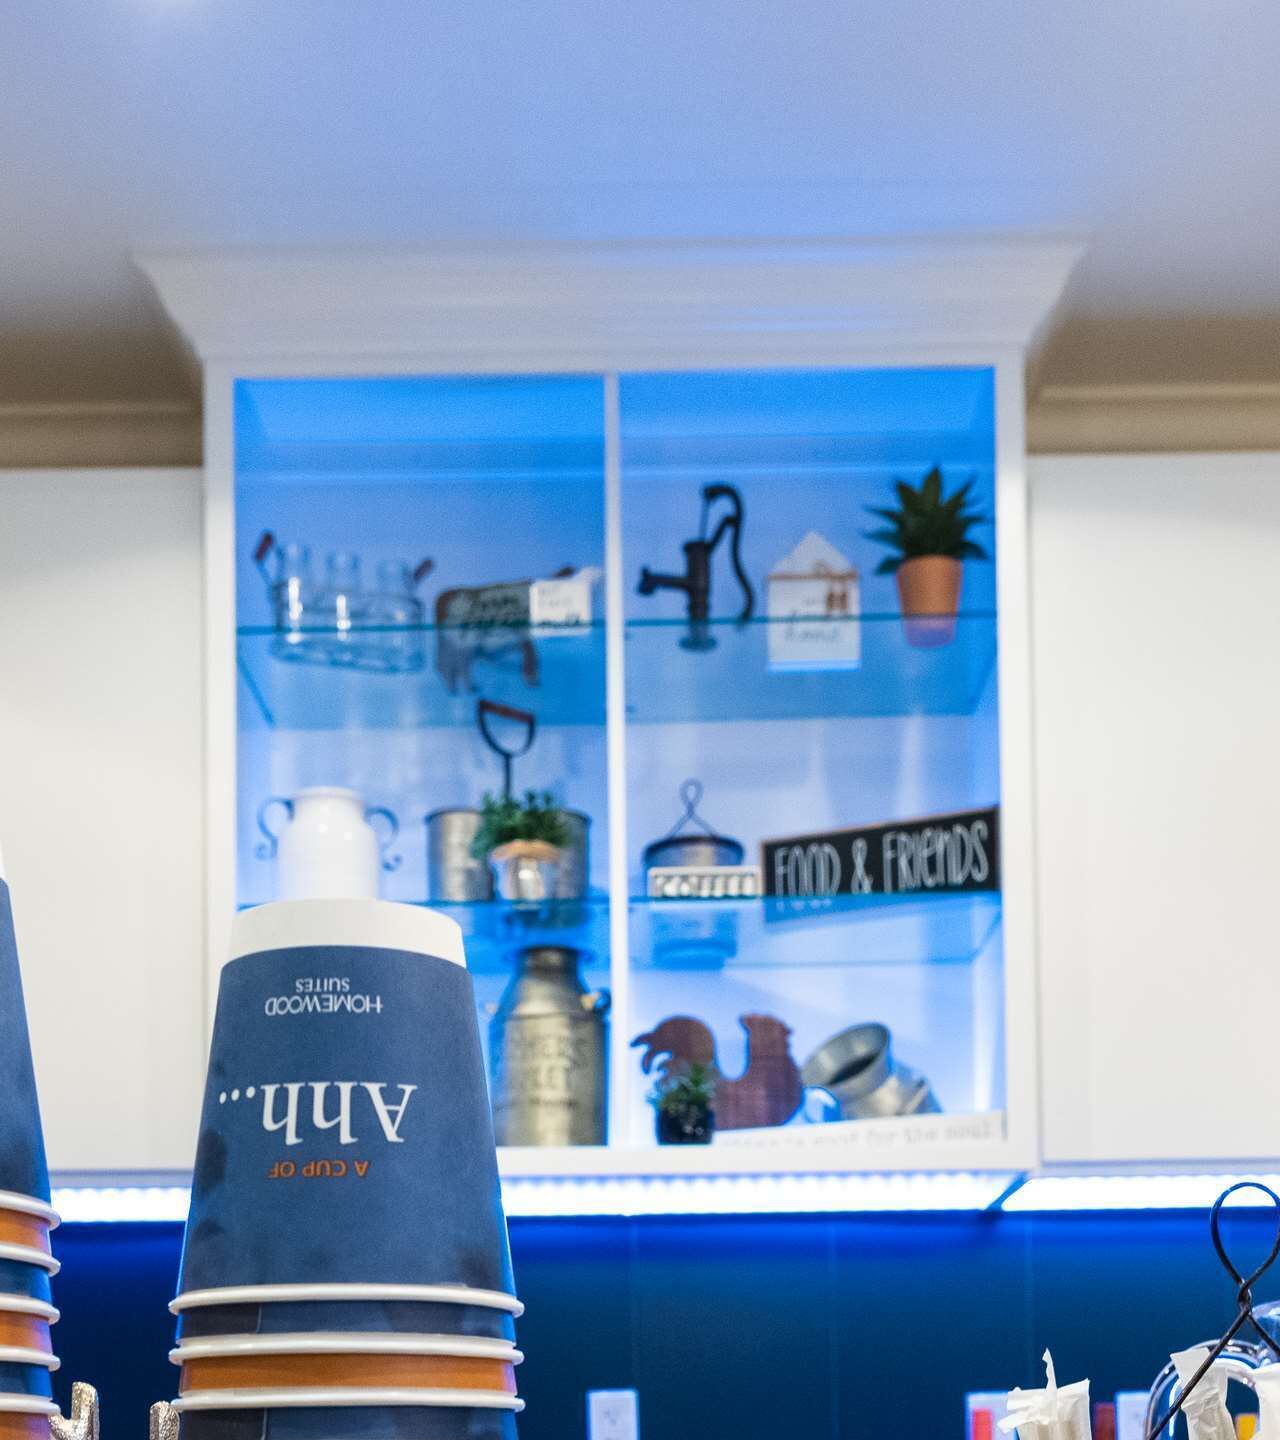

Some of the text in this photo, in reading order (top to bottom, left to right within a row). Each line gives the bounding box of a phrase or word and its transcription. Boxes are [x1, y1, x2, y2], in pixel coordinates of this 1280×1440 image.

[295, 977, 350, 993] SUITES
[264, 994, 384, 1017] HOMEWOOD
[219, 1081, 418, 1146] Ahh...
[269, 1159, 369, 1179] A CUP OF
